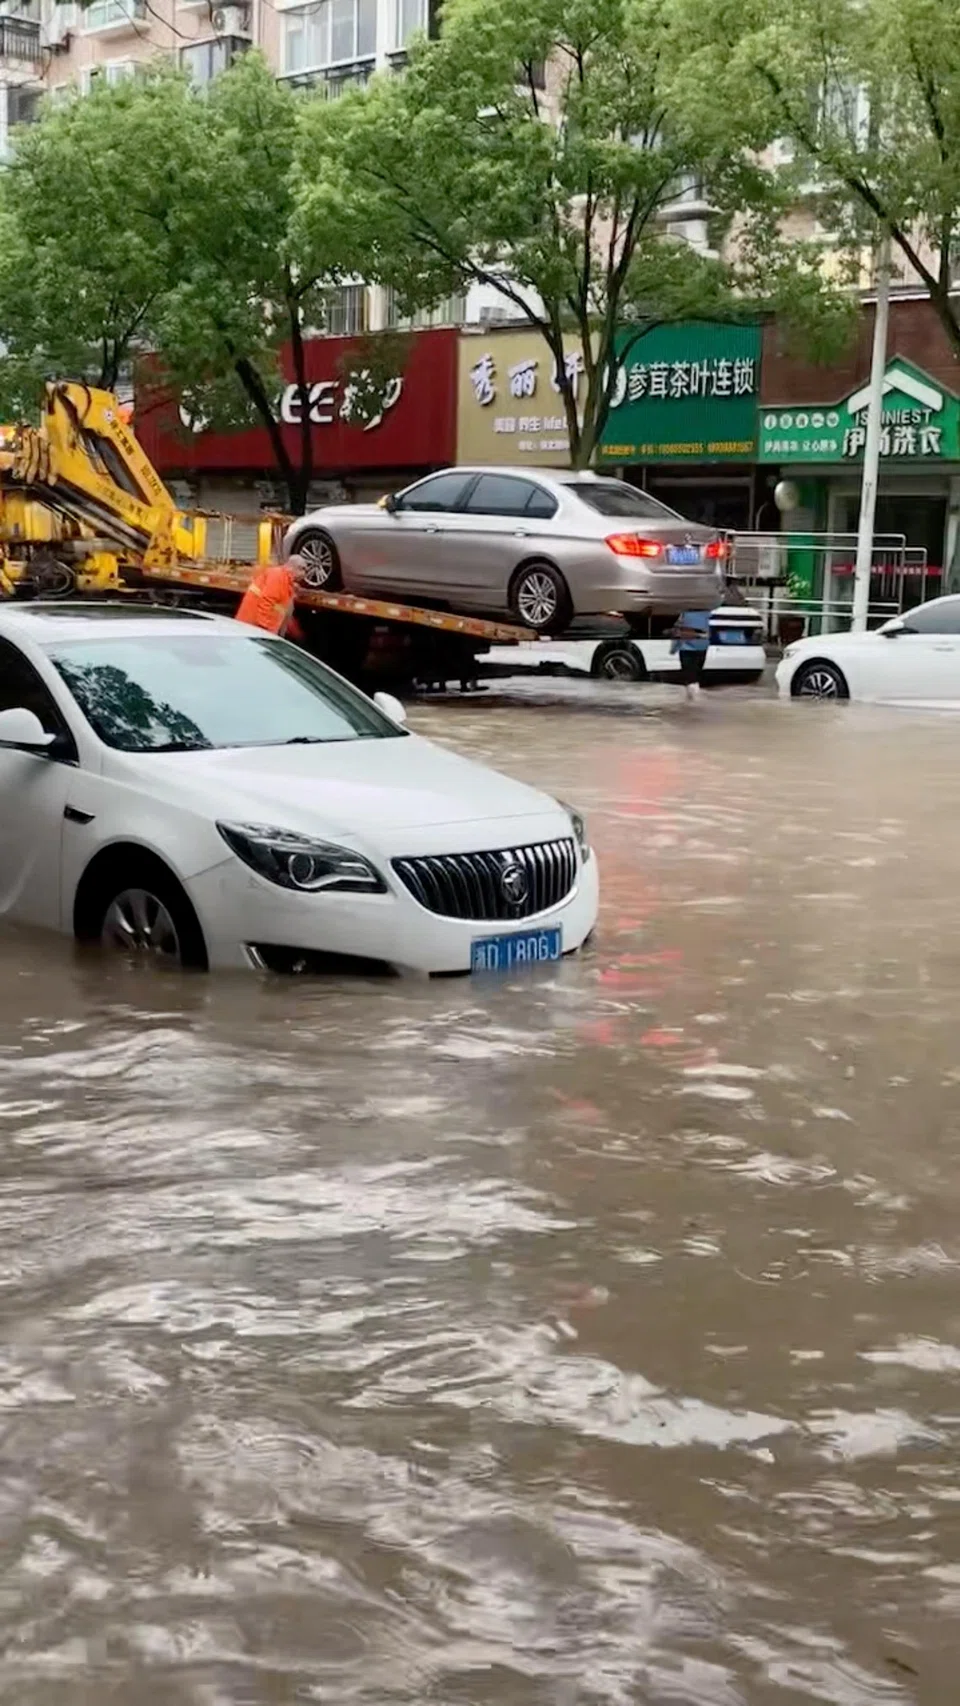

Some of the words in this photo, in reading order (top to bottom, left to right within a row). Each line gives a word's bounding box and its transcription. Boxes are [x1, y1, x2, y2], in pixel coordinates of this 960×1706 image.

[628, 358, 754, 401] 参茸茶叶连锁
[842, 426, 941, 456] 伊尚洗衣
